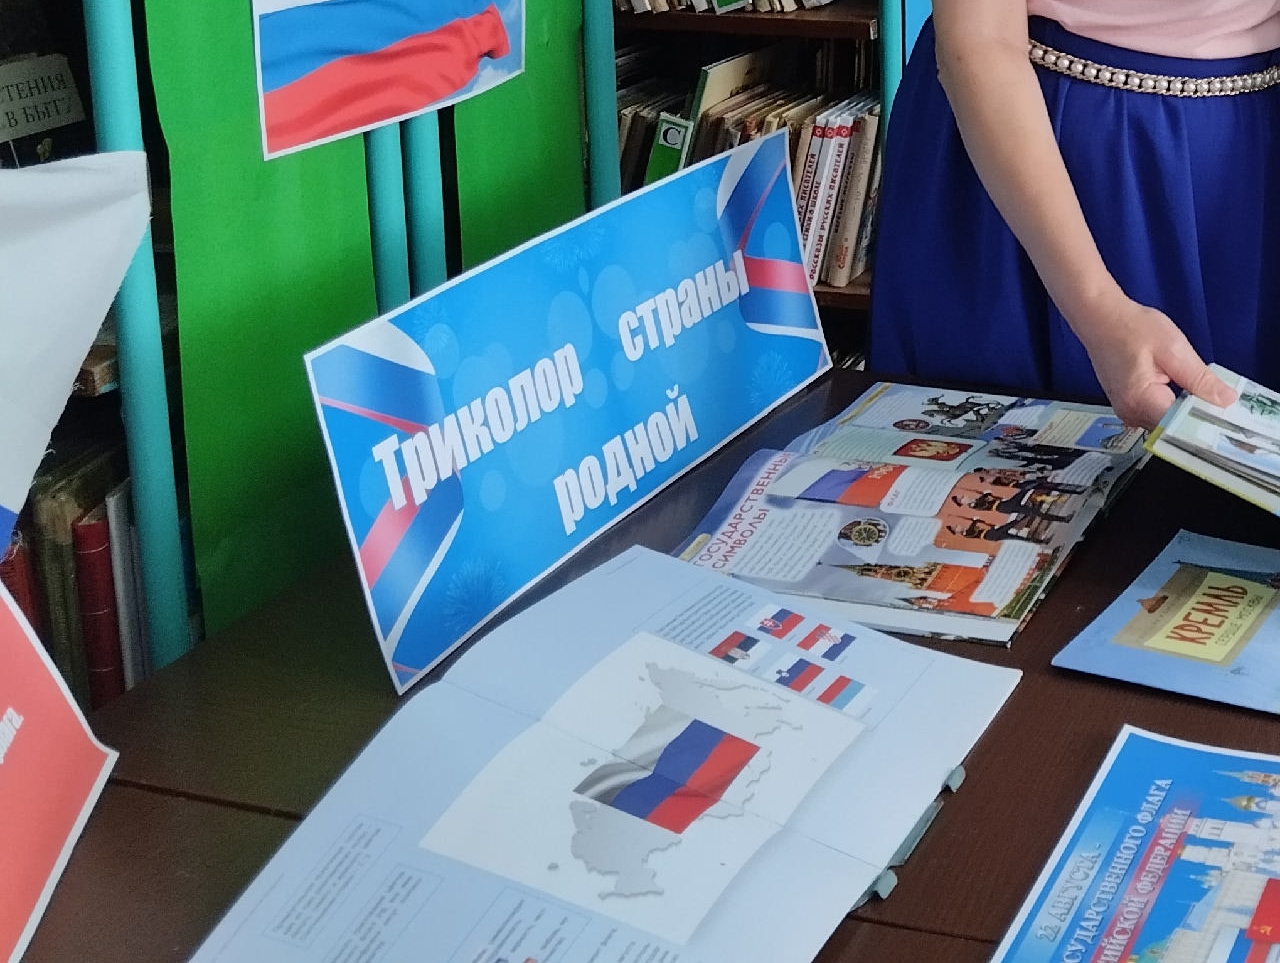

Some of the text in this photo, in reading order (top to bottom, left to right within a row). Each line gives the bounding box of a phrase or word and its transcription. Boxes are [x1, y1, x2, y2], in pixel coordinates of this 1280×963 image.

[662, 127, 682, 146] С
[373, 249, 750, 511] Триколор страны
[553, 382, 699, 536] родной
[711, 508, 770, 569] СИМВОЛЫ
[1165, 584, 1248, 646] КРЕМЛЬ
[1048, 849, 1101, 923] АВГУСТА
[1060, 778, 1174, 963] СУДАРСТВЕННОГО ФЛАГА
[1136, 807, 1193, 896] ФЕДЕРАЦИИ
[1037, 923, 1063, 942] 22
